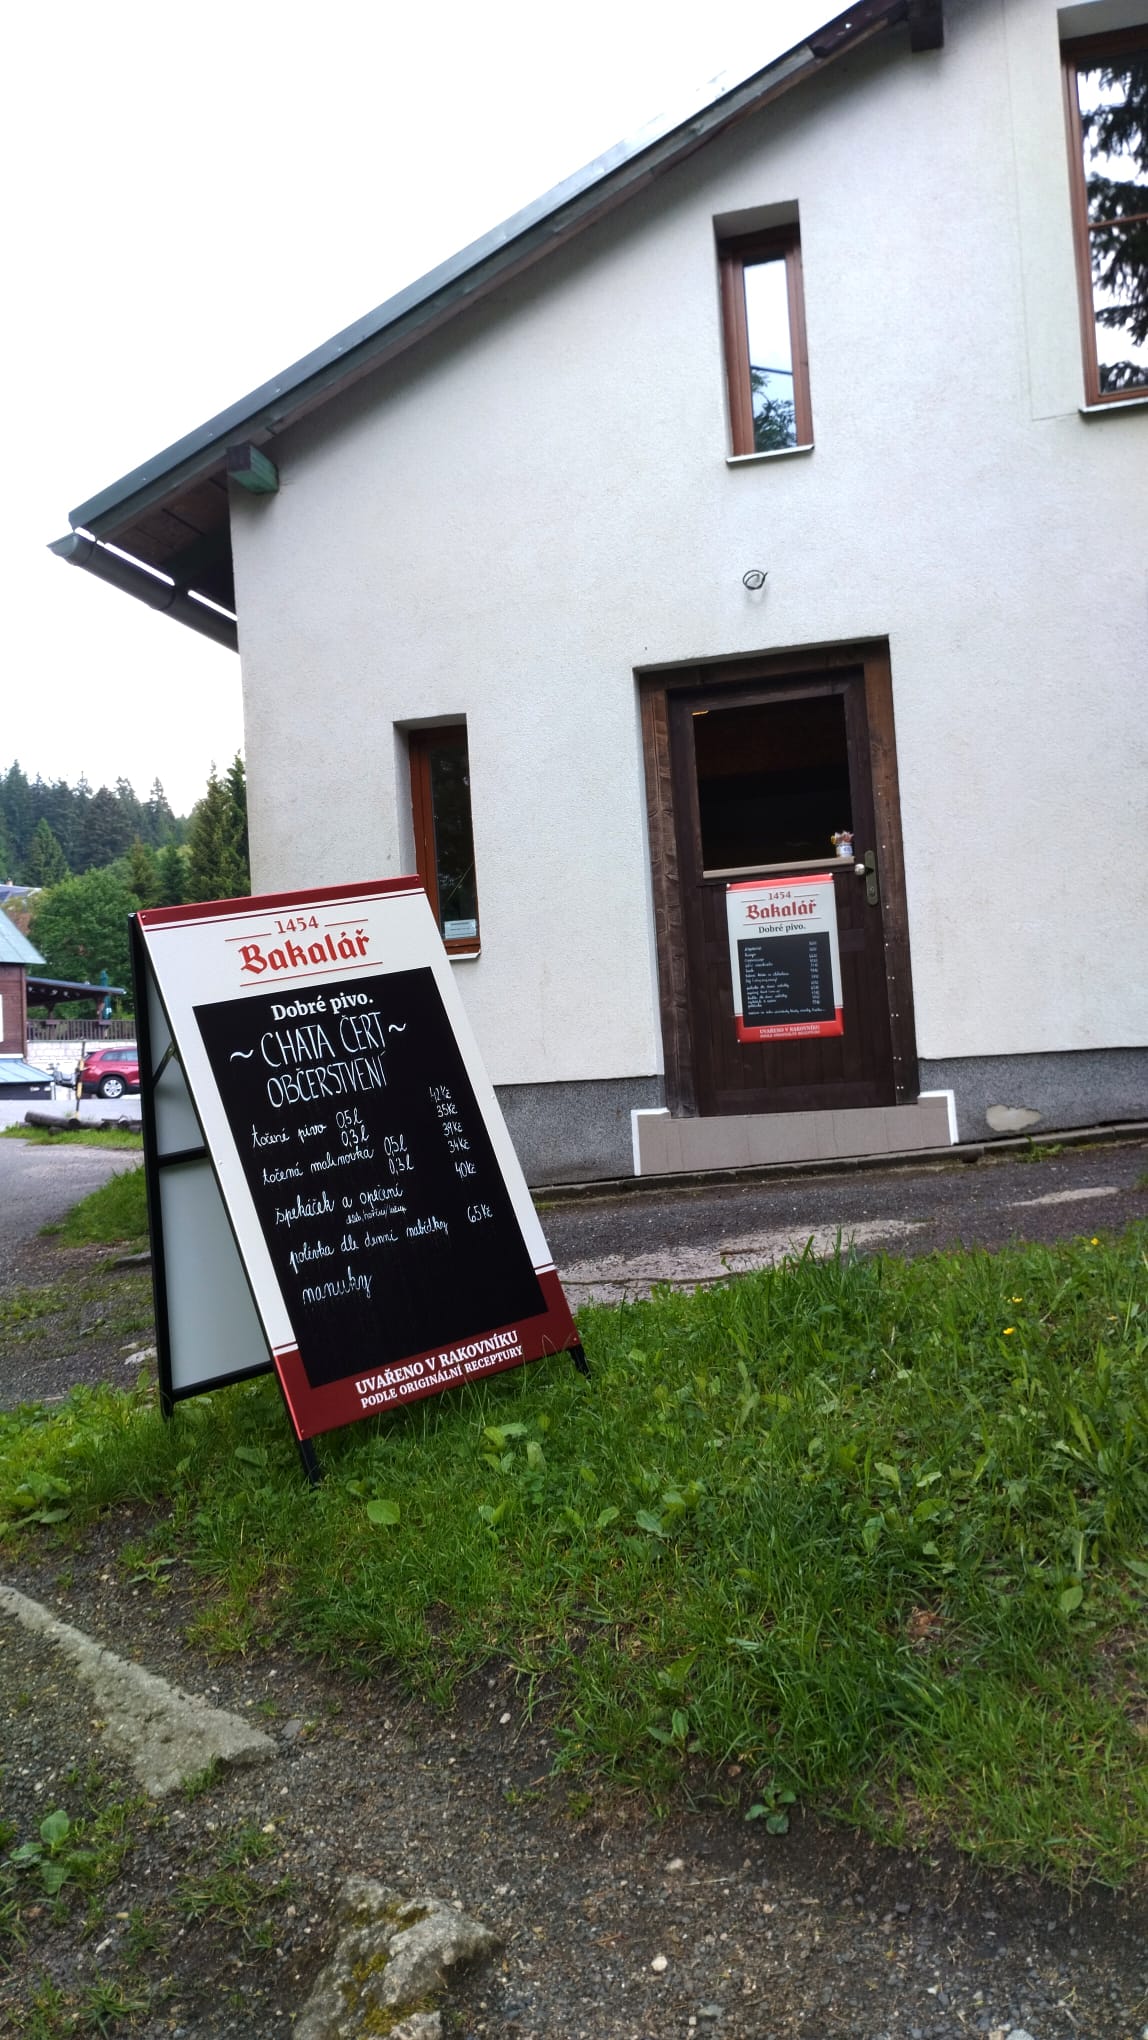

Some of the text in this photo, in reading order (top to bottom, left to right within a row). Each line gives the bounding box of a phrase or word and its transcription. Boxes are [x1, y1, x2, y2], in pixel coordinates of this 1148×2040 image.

[746, 900, 817, 920] Bakalář
[768, 891, 791, 900] 1454
[275, 915, 319, 934] 1454
[758, 923, 806, 934] Dobré pivo.
[238, 929, 370, 975] Bakalář
[271, 992, 373, 1021] Dobré pivo.
[260, 1011, 386, 1068] CHATA ČERT
[267, 1051, 387, 1108] OBČERSTVENÍ
[436, 1102, 458, 1118] 35Kč
[251, 1123, 290, 1148] točené
[298, 1124, 328, 1144] pivo
[263, 1162, 303, 1186] točená
[310, 1145, 375, 1174] malinovka
[442, 1121, 463, 1137] 39Kč
[447, 1136, 471, 1154] 34Kč
[275, 1190, 335, 1229] špekáček
[342, 1196, 353, 1209] a
[455, 1160, 477, 1179] 40Kč
[289, 1203, 493, 1275] polévka dle denní nabídky 65Kč
[302, 1265, 373, 1305] nanuky
[355, 1330, 518, 1395] UVAŘENO V RAKOVNÍKU
[360, 1345, 523, 1409] PODLE ORIGINÁLNÍ RECEPTURY
